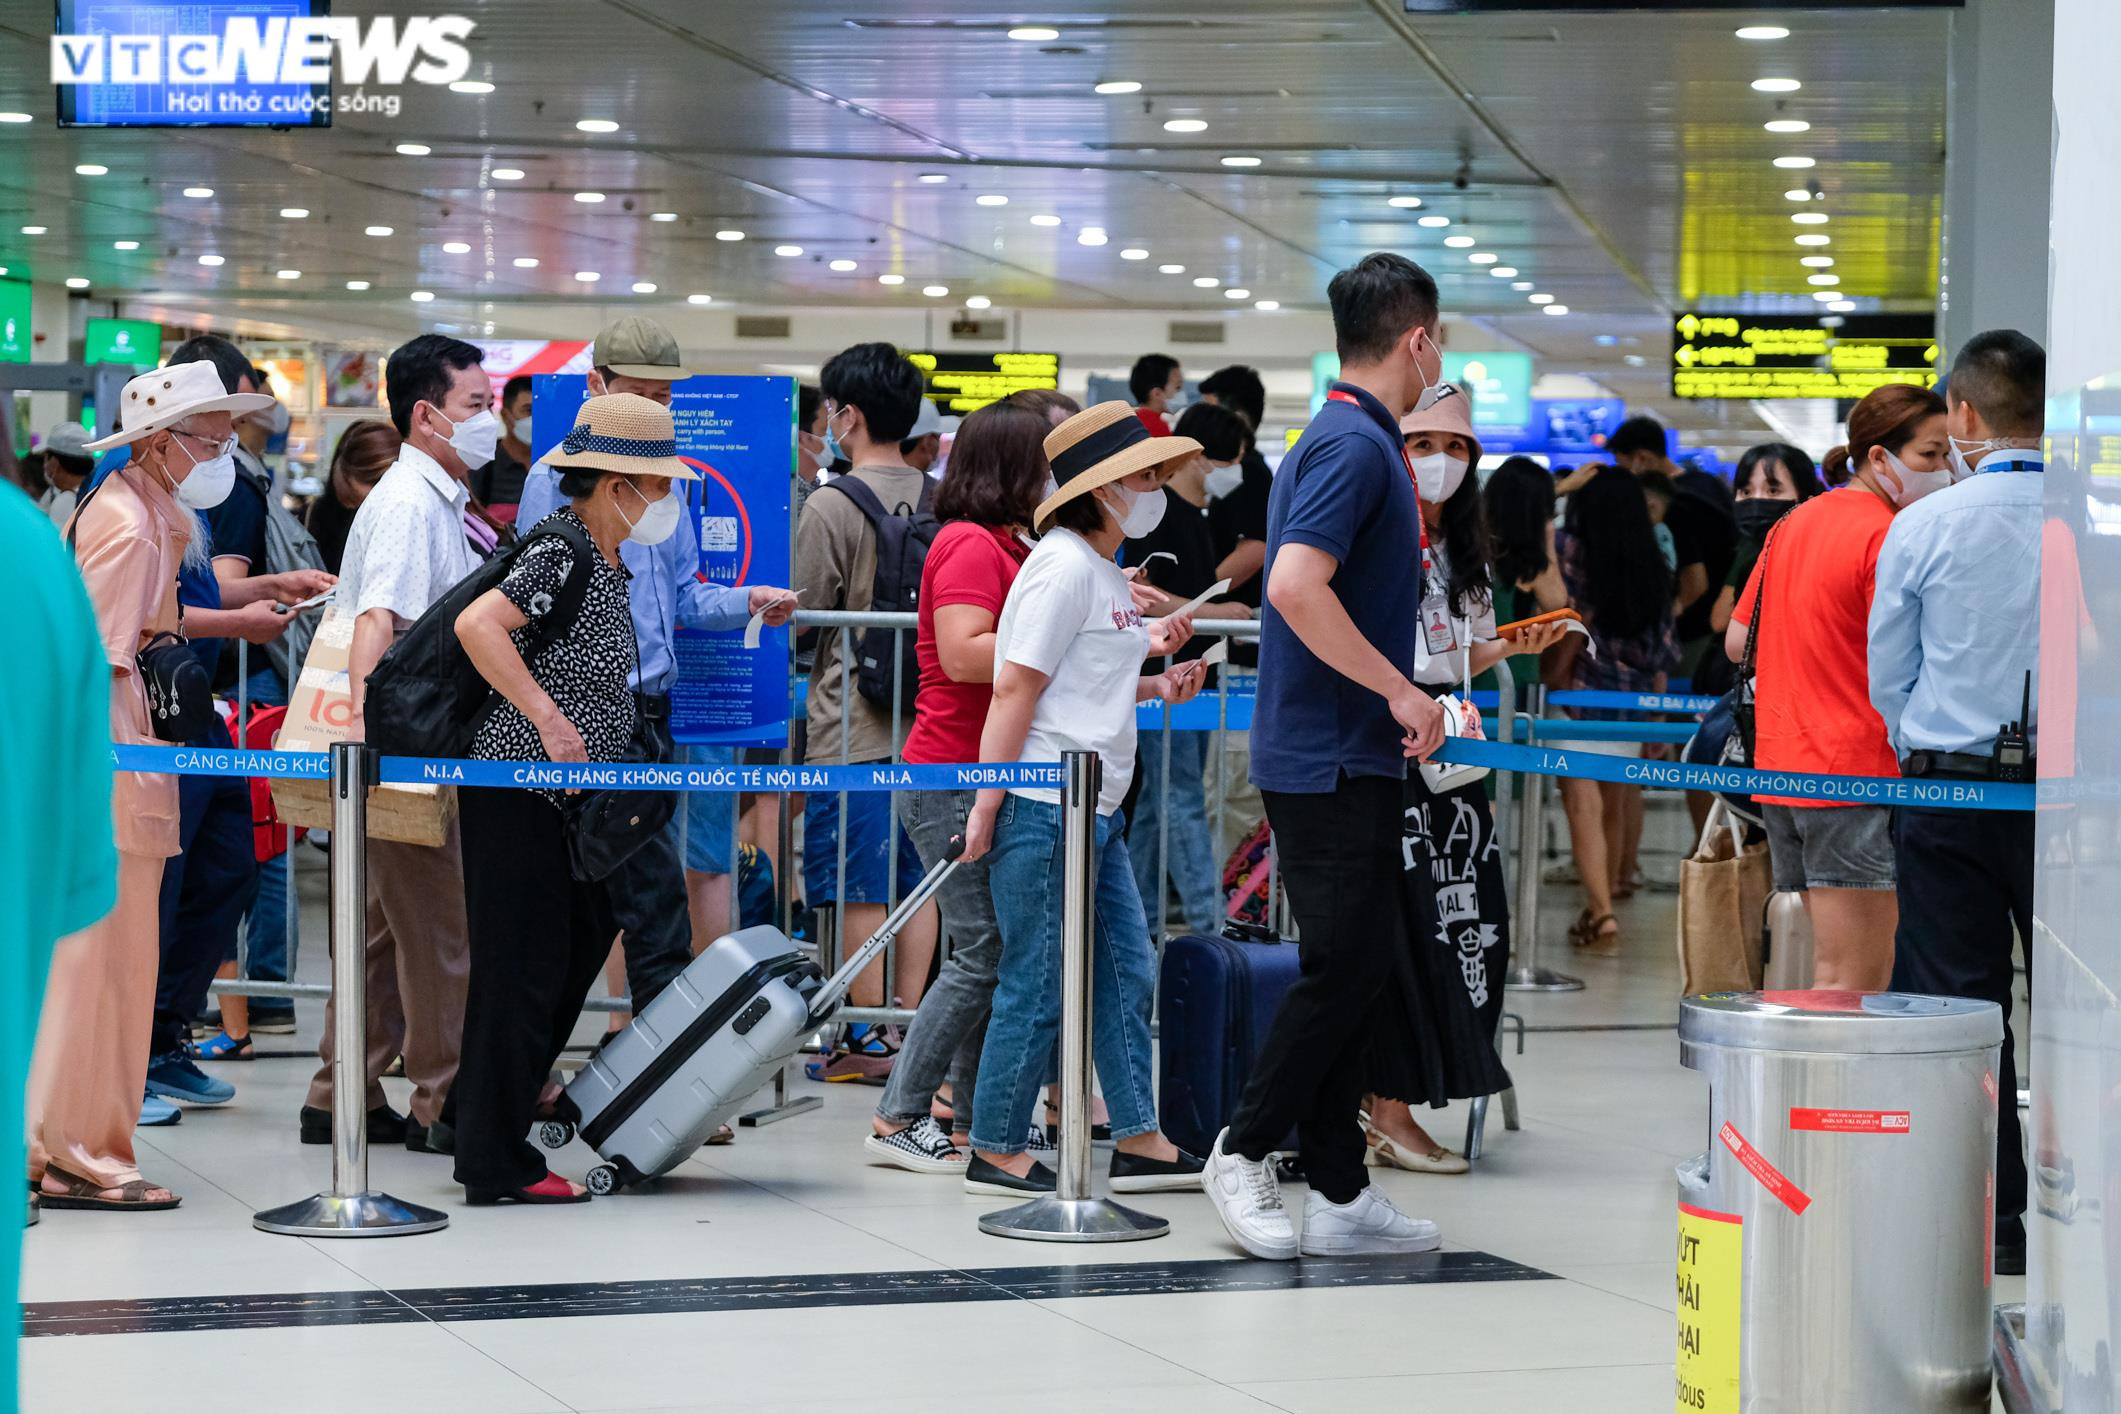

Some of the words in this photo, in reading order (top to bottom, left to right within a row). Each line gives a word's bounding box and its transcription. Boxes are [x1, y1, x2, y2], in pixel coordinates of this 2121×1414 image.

[720, 419, 733, 427] TAY
[234, 753, 287, 771] HÀNG
[424, 764, 464, 780] N.I.A
[513, 765, 563, 783] CẢNG
[623, 768, 682, 785] KHÔNG
[687, 767, 736, 786] QUỐC
[742, 767, 762, 785] TẾ
[766, 769, 795, 789] NỘI
[801, 769, 829, 786] BÀI
[872, 770, 912, 784] N.I.A
[1746, 774, 1817, 793] KHÔNG
